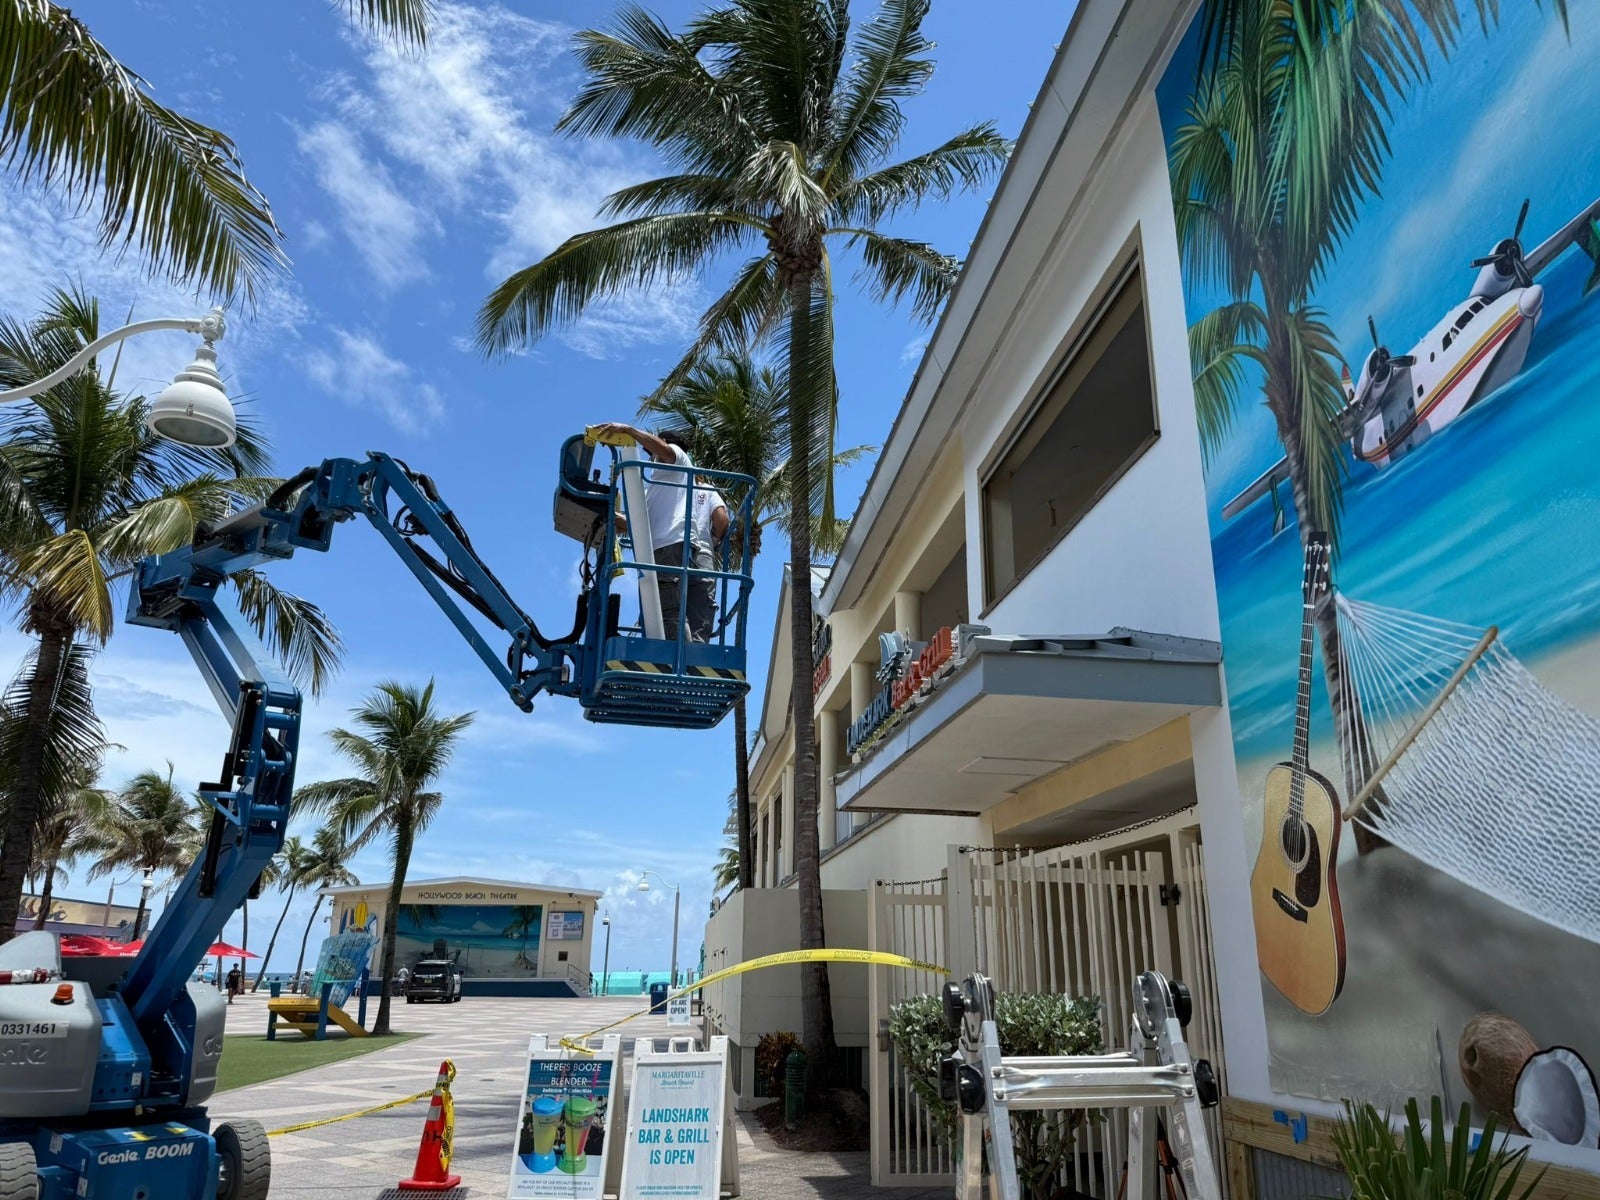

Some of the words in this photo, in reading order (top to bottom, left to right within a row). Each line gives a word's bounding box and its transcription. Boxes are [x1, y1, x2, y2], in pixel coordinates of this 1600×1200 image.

[919, 627, 952, 678] Grill
[418, 891, 463, 900] HOLLYWOOD
[465, 891, 486, 900] BEACH
[490, 891, 518, 900] THEATRE
[670, 1006, 687, 1015] OPEN!
[1, 1023, 56, 1035] 0331461
[540, 1062, 571, 1072] THERE'S
[573, 1063, 602, 1072] BOOZE
[652, 1070, 705, 1079] MARGARITAVILLE
[550, 1077, 587, 1086] BLENDER
[641, 1107, 709, 1123] LANDSHARK
[638, 1128, 661, 1144] BAR
[664, 1128, 673, 1144] &
[677, 1128, 710, 1144] GRILL
[97, 1149, 139, 1165] Genie
[145, 1142, 194, 1160] BOOM
[649, 1149, 661, 1165] IS
[664, 1149, 695, 1165] OPEN
